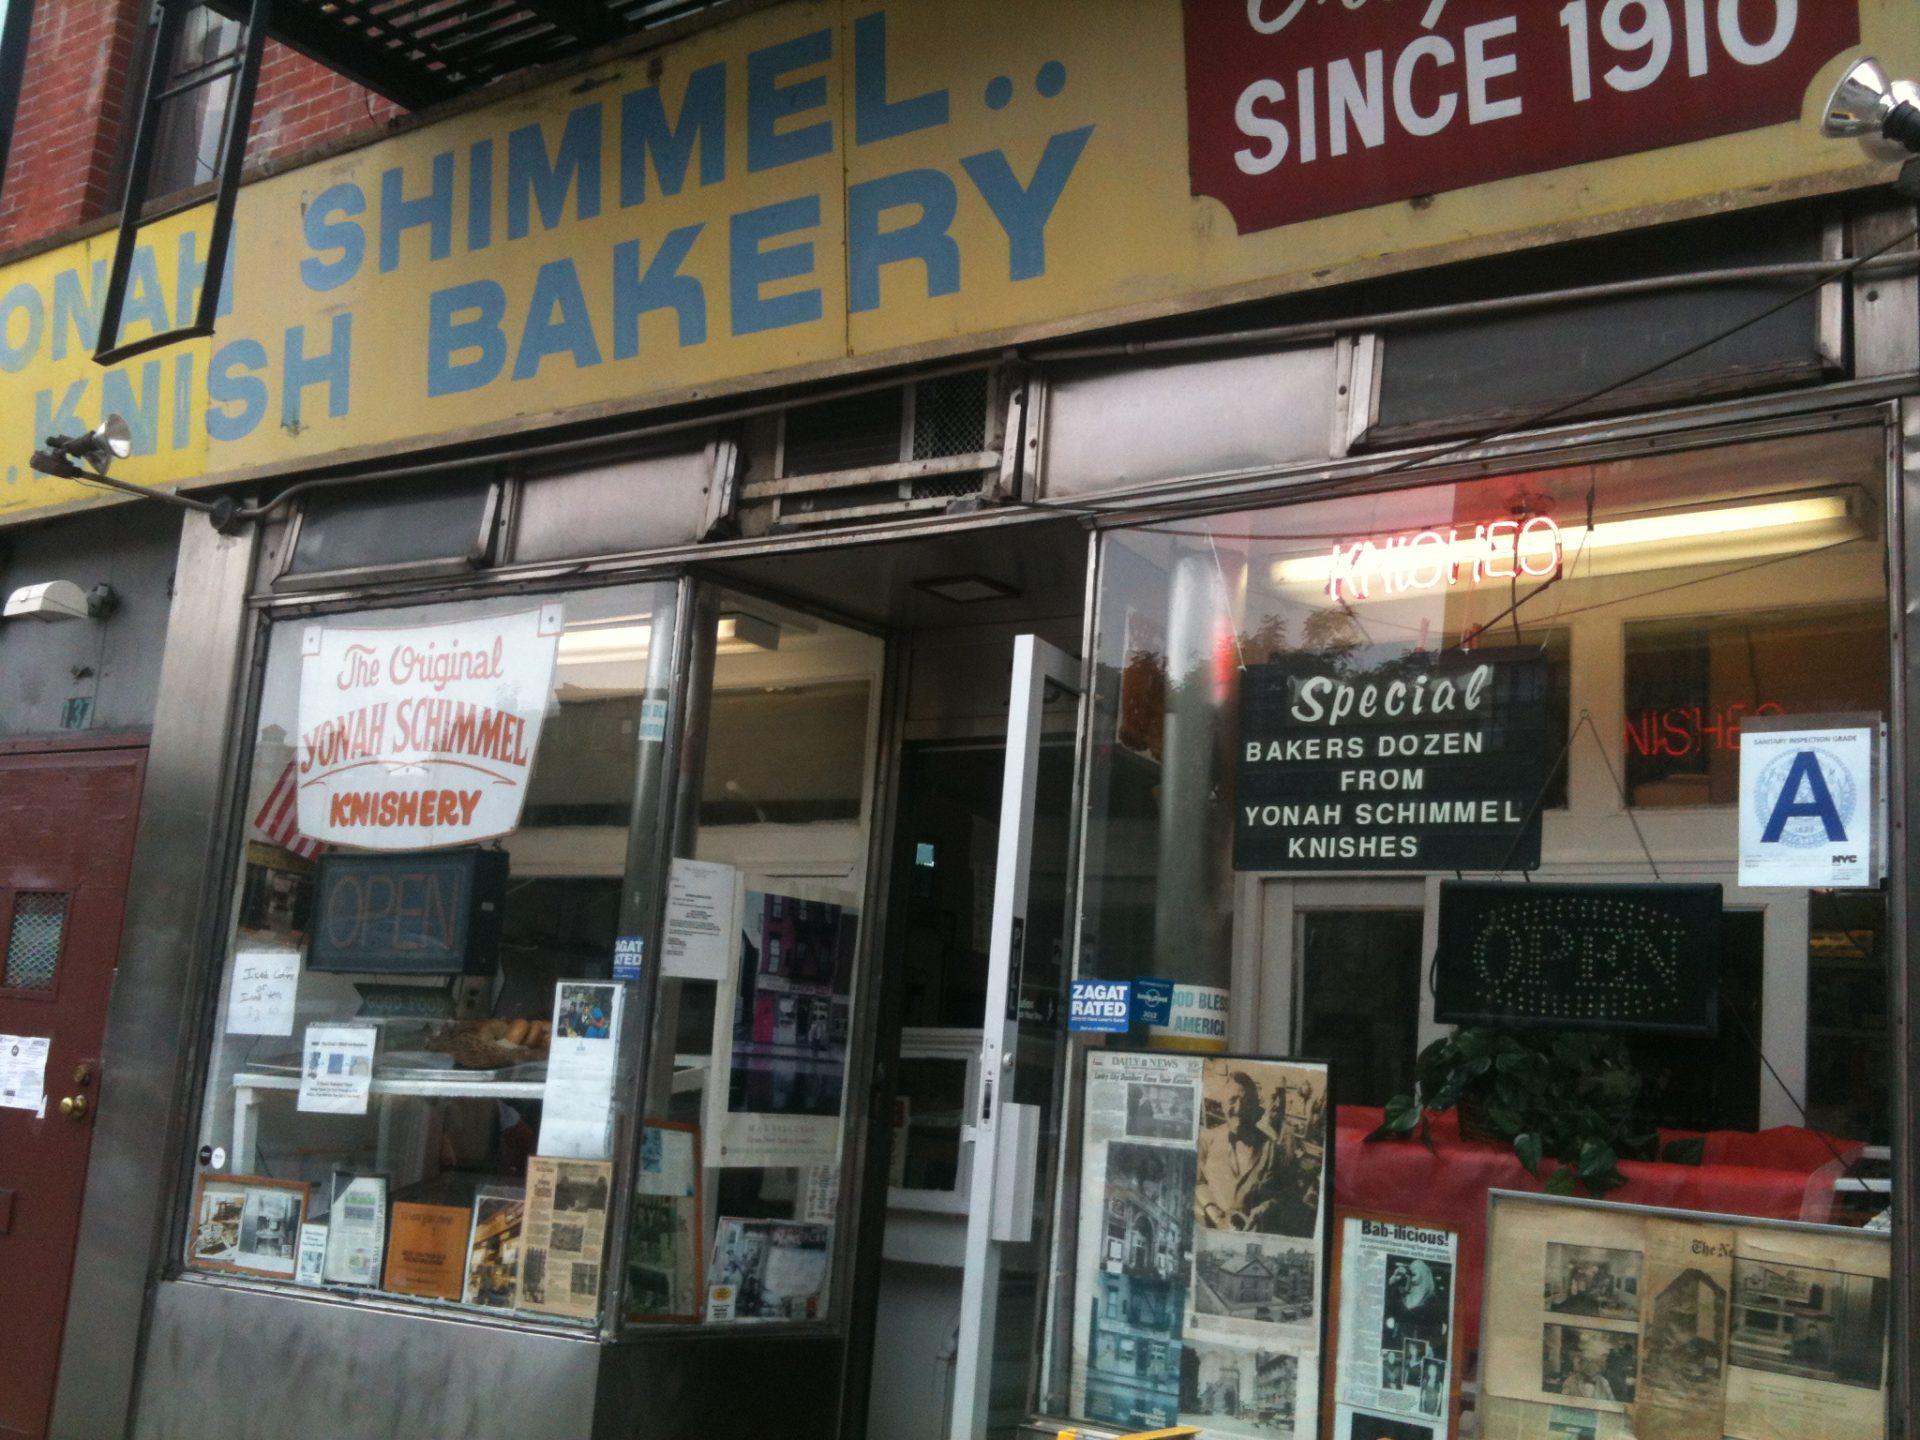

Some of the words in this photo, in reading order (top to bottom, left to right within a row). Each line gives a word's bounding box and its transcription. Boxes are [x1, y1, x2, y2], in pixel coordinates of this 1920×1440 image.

[1233, 15, 1523, 177] SINCE
[1561, 0, 1798, 102] 1910
[34, 313, 351, 482] KNISH
[427, 124, 1096, 398] BAKERY
[337, 643, 380, 691] The
[389, 635, 504, 691] Original
[1291, 663, 1490, 726] Special
[301, 702, 389, 773] YONAH
[393, 695, 529, 768] SCHIMMEL
[1246, 736, 1365, 763] BAKERS
[1377, 731, 1484, 757] DOZEN
[1832, 734, 1857, 743] GRADE
[1340, 768, 1424, 792] FROM
[329, 789, 483, 829] KNISHERY
[1245, 803, 1342, 827] YONAH
[1355, 799, 1522, 826] SCHIMMEL
[1760, 751, 1849, 843] A
[1288, 835, 1419, 860] KNISHES
[1832, 854, 1858, 863] NYC
[1072, 984, 1128, 1000] ZAGAT
[1071, 1001, 1127, 1017] RATED
